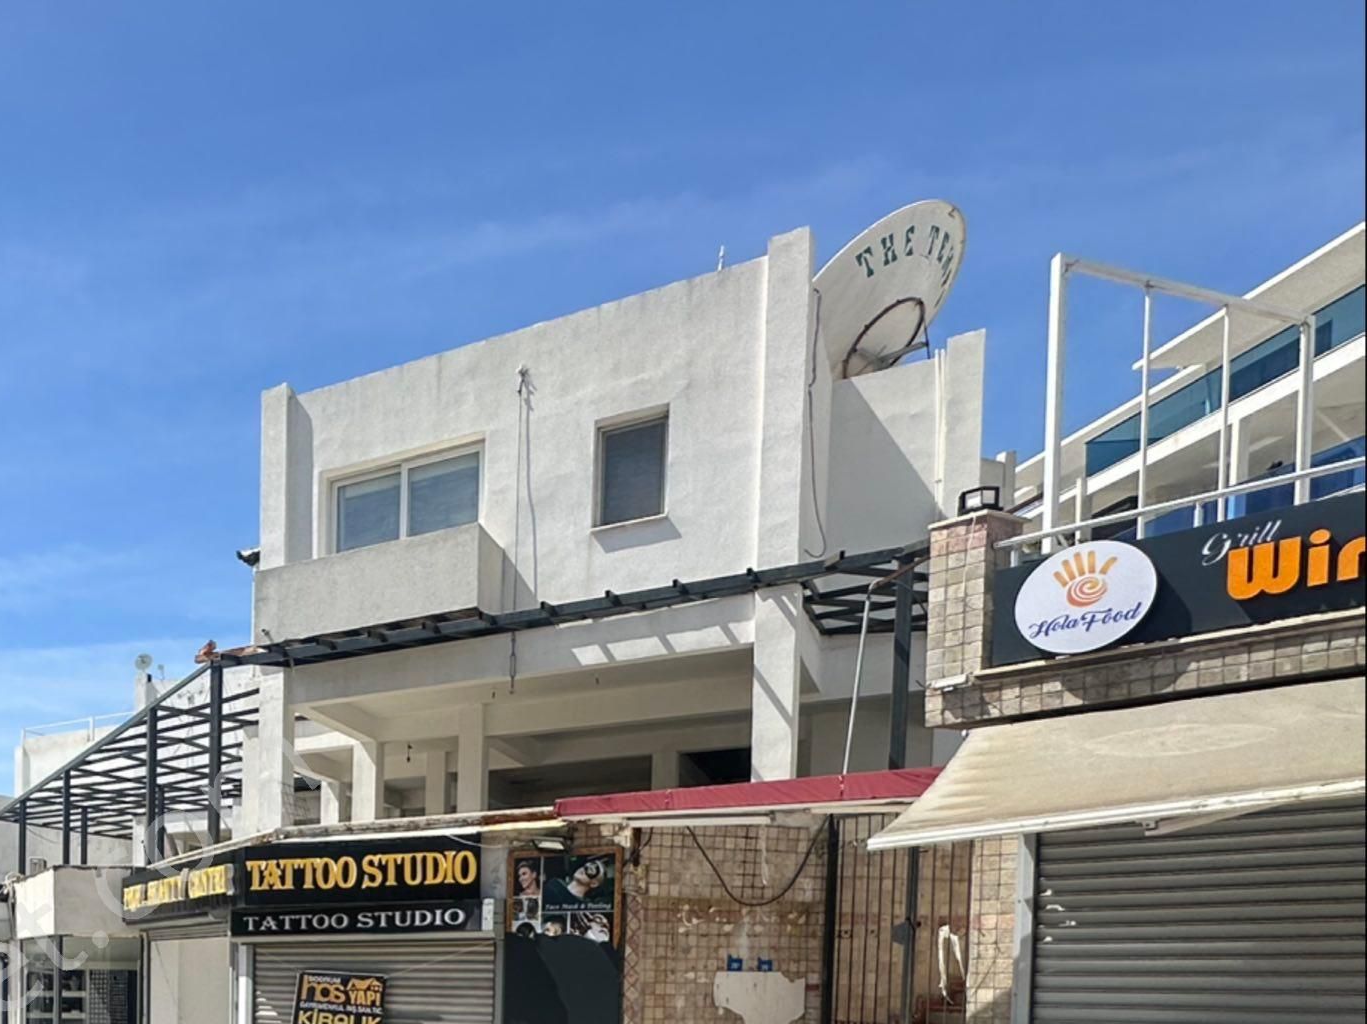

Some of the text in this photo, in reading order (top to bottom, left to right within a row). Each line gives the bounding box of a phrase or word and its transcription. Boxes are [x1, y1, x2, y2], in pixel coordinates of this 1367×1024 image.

[855, 225, 916, 278] THE
[1080, 602, 1142, 633] Food
[246, 850, 477, 891] TATTOO STUDIO
[243, 907, 466, 931] TATTOO STUDIO
[348, 989, 382, 1006] YAPI
